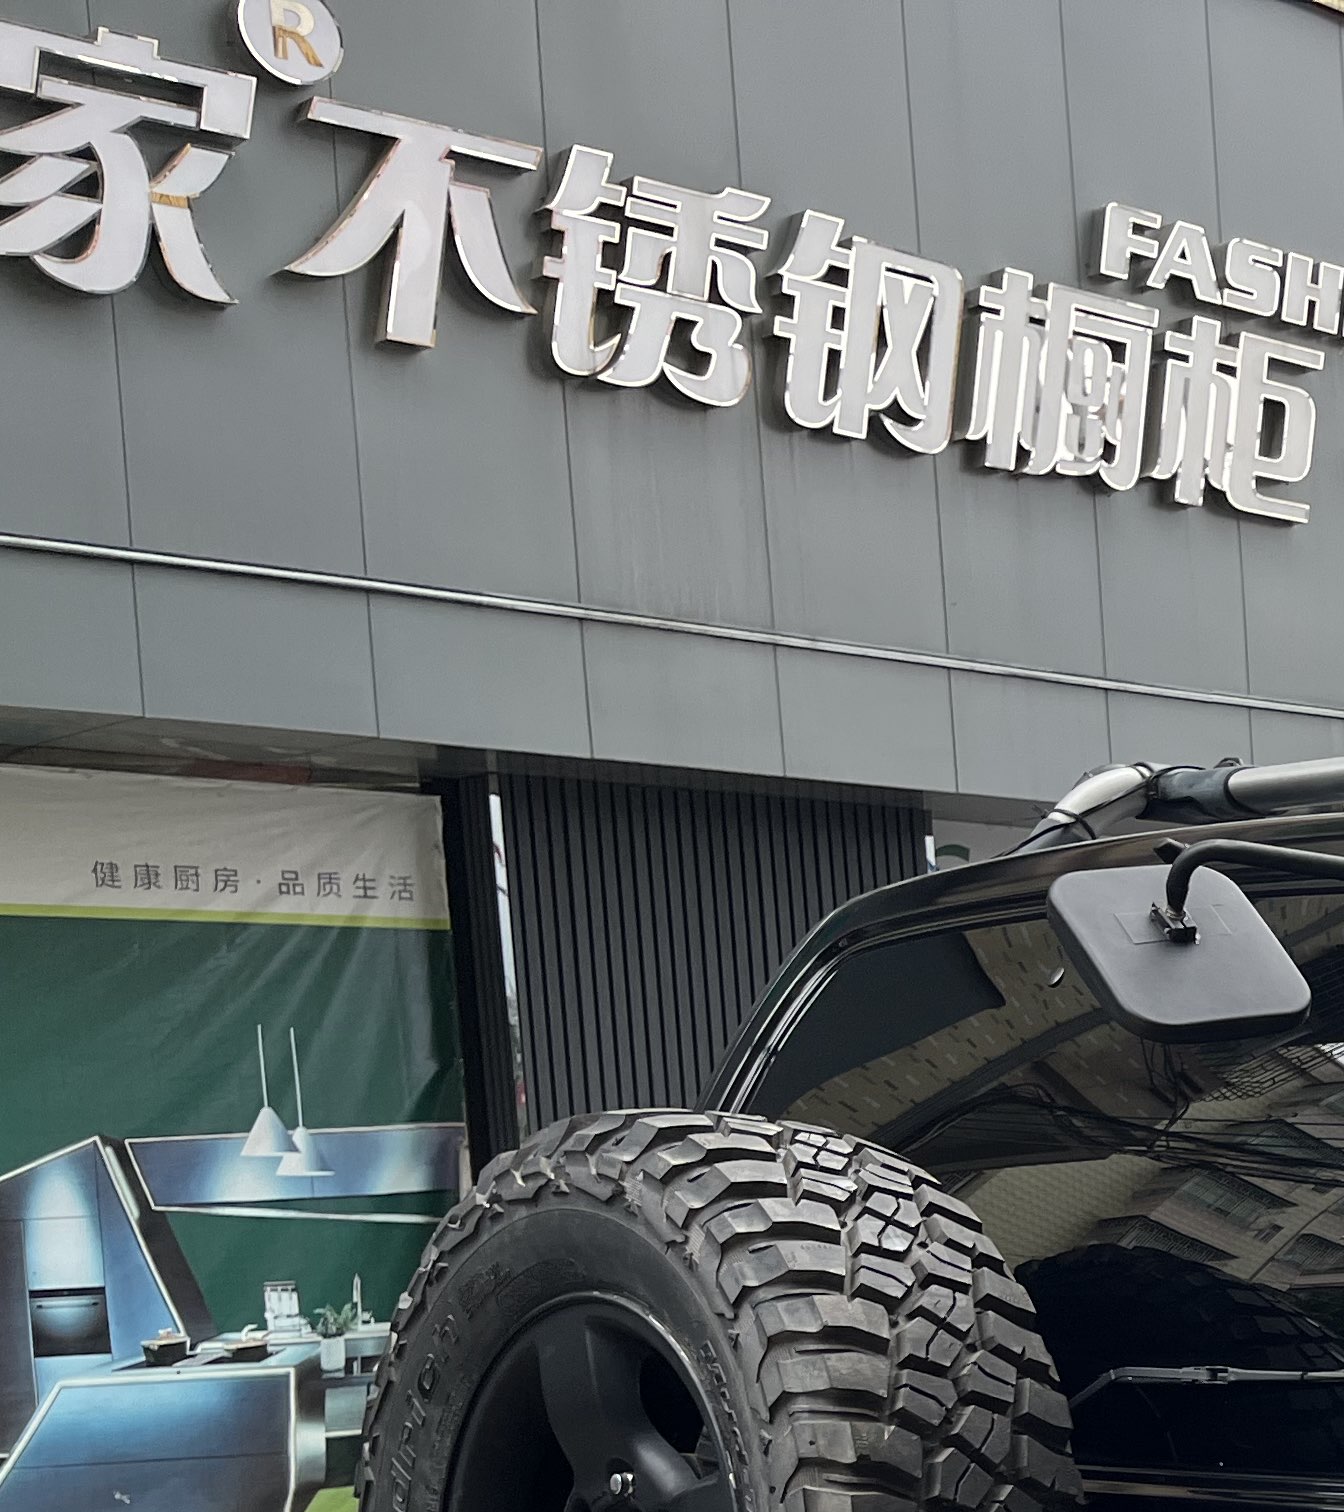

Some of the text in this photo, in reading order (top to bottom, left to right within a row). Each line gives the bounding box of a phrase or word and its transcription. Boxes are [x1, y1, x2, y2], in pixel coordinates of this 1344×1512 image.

[90, 859, 416, 902] 健康厨房·品质生活
